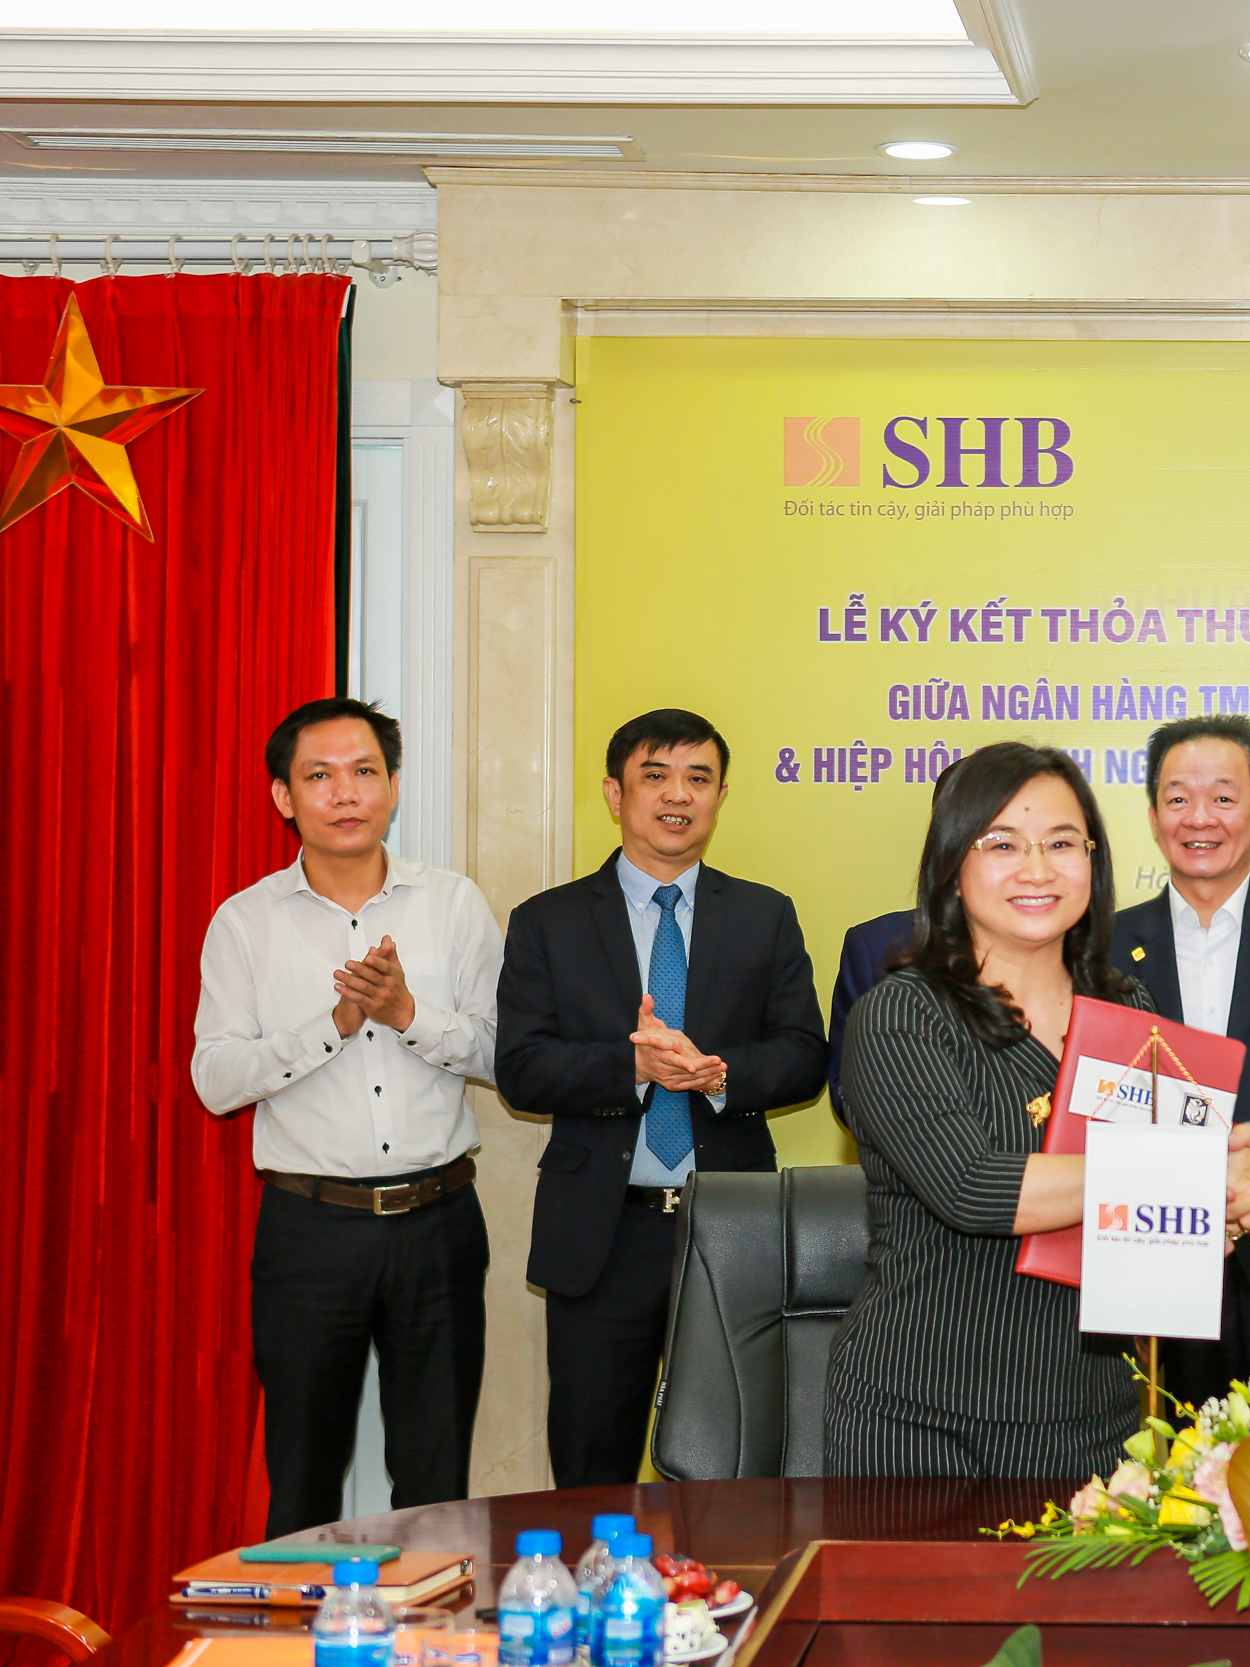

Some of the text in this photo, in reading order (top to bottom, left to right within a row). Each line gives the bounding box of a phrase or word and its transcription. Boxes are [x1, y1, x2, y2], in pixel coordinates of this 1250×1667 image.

[882, 415, 1075, 489] SHB
[784, 499, 1074, 520] Đối tác tin cậy, giải pháp phù hợp
[819, 593, 868, 642] LỄ
[880, 601, 938, 642] KÝ
[950, 597, 1032, 642] KẾT
[1041, 597, 1168, 642] THỎA
[889, 677, 970, 721] GIỮA
[982, 677, 1080, 721] NGÂN
[1092, 676, 1187, 721] HÀNG
[775, 748, 801, 783] &
[813, 740, 893, 791] HIỆP
[1135, 1203, 1211, 1236] SHB
